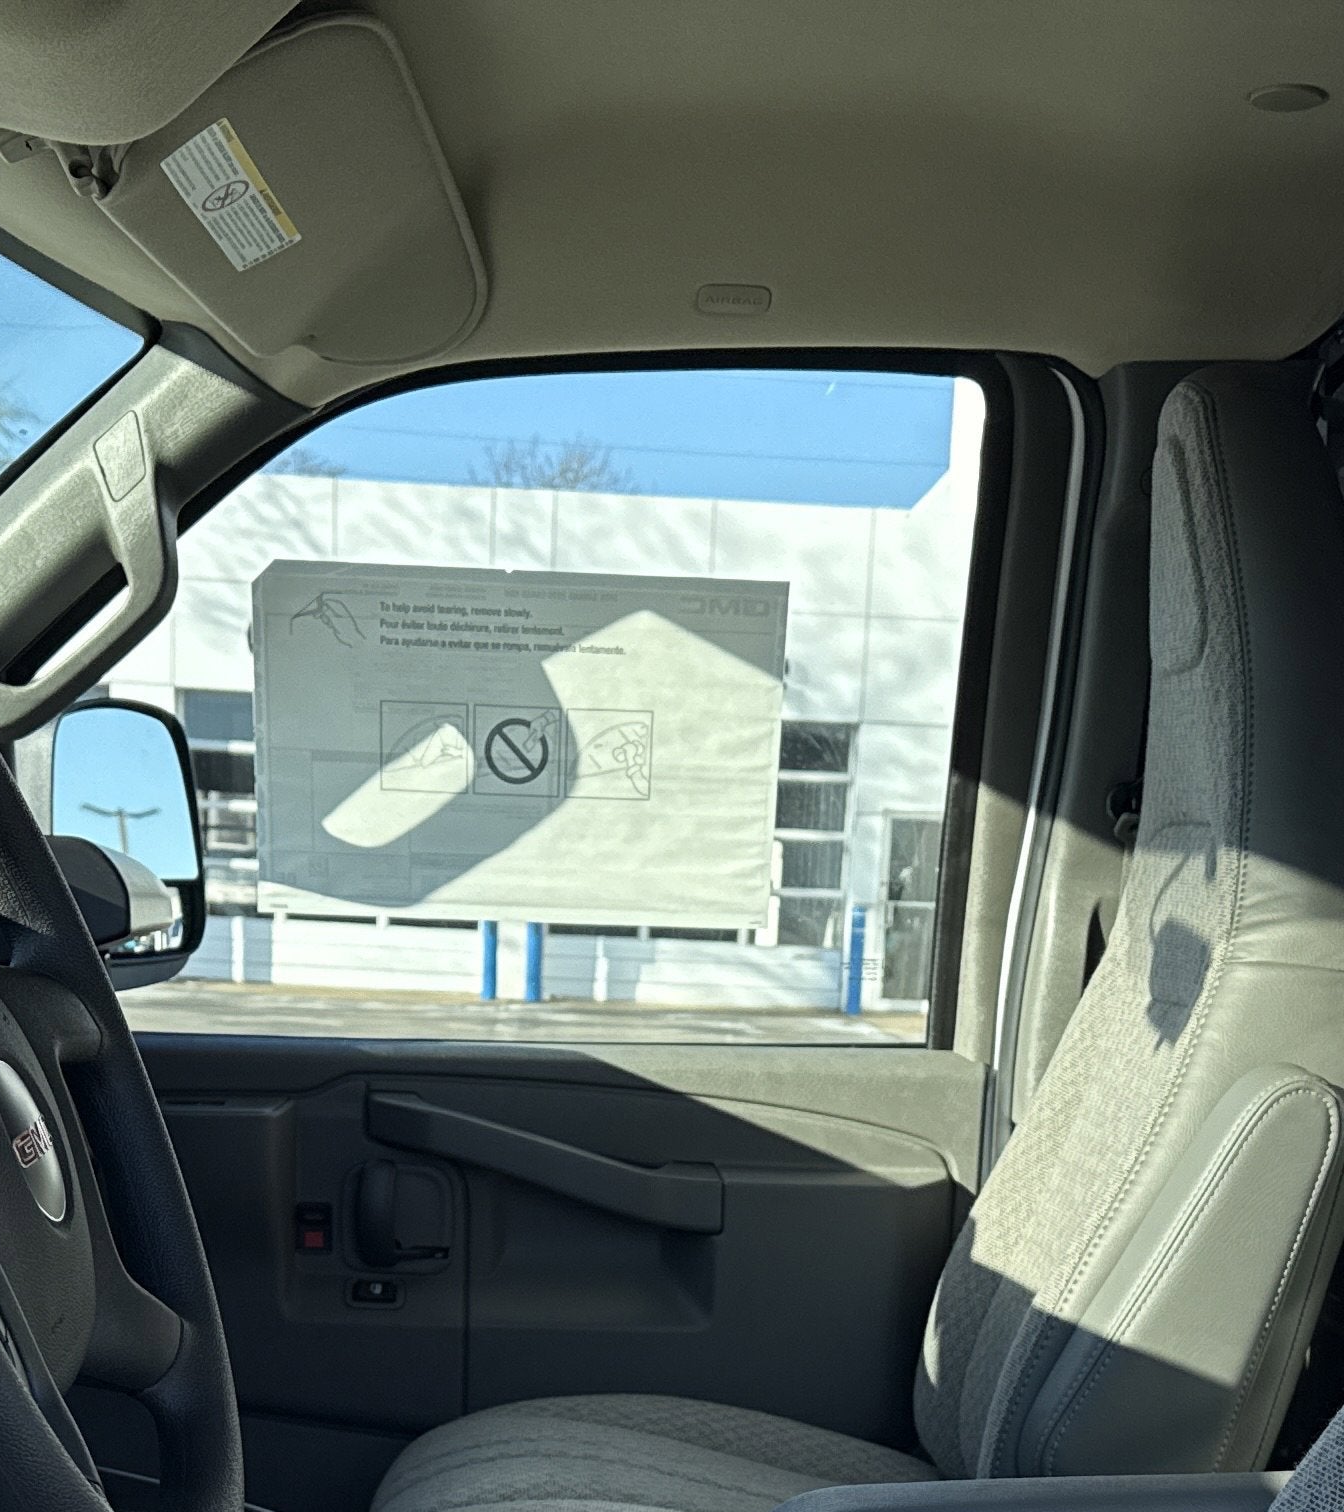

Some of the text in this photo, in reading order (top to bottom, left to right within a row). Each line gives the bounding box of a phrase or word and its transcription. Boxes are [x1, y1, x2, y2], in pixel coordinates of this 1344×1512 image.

[704, 295, 764, 306] AIRBAG
[379, 601, 533, 619] To help avoid tearing, remove slowly.
[380, 618, 399, 628] Pour
[401, 618, 425, 630] éviter
[427, 620, 448, 631] toute
[494, 623, 519, 634] retirer
[380, 635, 399, 645] Para
[448, 639, 472, 650] evitar
[473, 641, 489, 651] que
[12, 1114, 53, 1168] GMC
